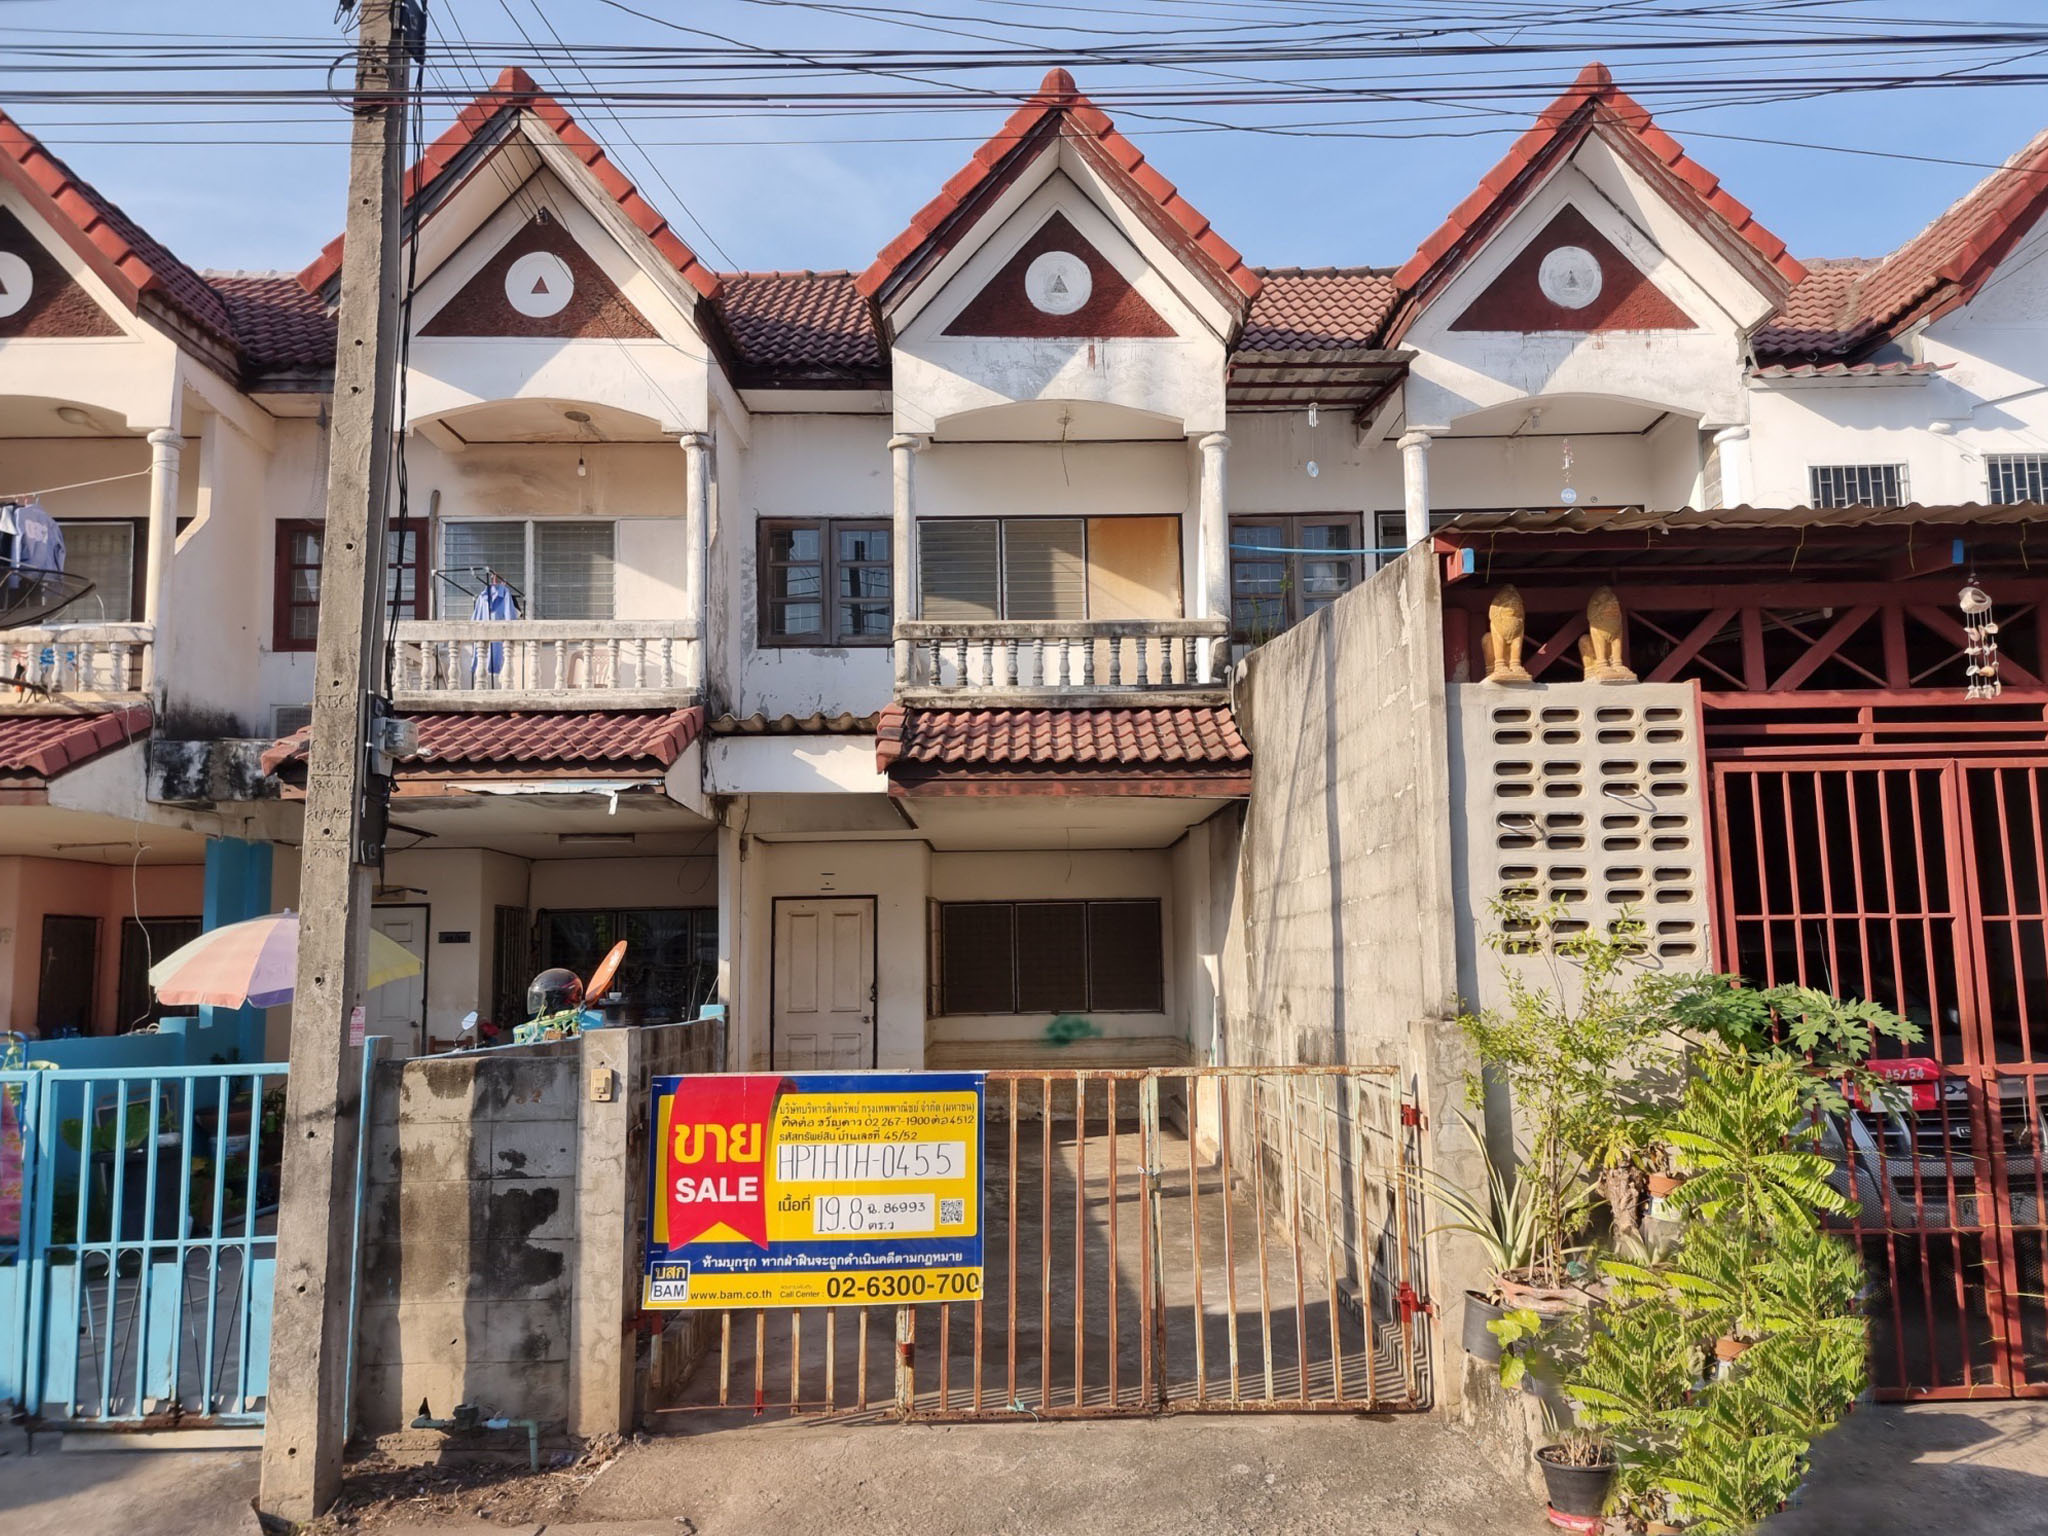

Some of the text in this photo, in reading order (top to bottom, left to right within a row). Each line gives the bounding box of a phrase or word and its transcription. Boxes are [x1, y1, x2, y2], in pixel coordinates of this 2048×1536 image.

[1884, 1066, 1925, 1082] 45/54
[943, 1103, 975, 1114] (มหาชน)
[864, 1117, 879, 1127] 02
[673, 1122, 762, 1164] ขาย
[884, 1129, 918, 1142] 45/52
[777, 1142, 952, 1180] HPTHTH-0455
[675, 1176, 759, 1203] SALE
[777, 1194, 811, 1212] เนื้อที่
[883, 1201, 926, 1214] 86993
[817, 1196, 865, 1232] 19.8
[702, 1255, 757, 1271] ห้ามบุกรุก
[655, 1265, 686, 1280] บสก
[653, 1284, 685, 1298] BAM
[780, 1290, 794, 1298] Call
[795, 1290, 820, 1298] Center
[826, 1272, 980, 1299] 02-6300-700
[690, 1289, 772, 1300] www.bam.co.th
